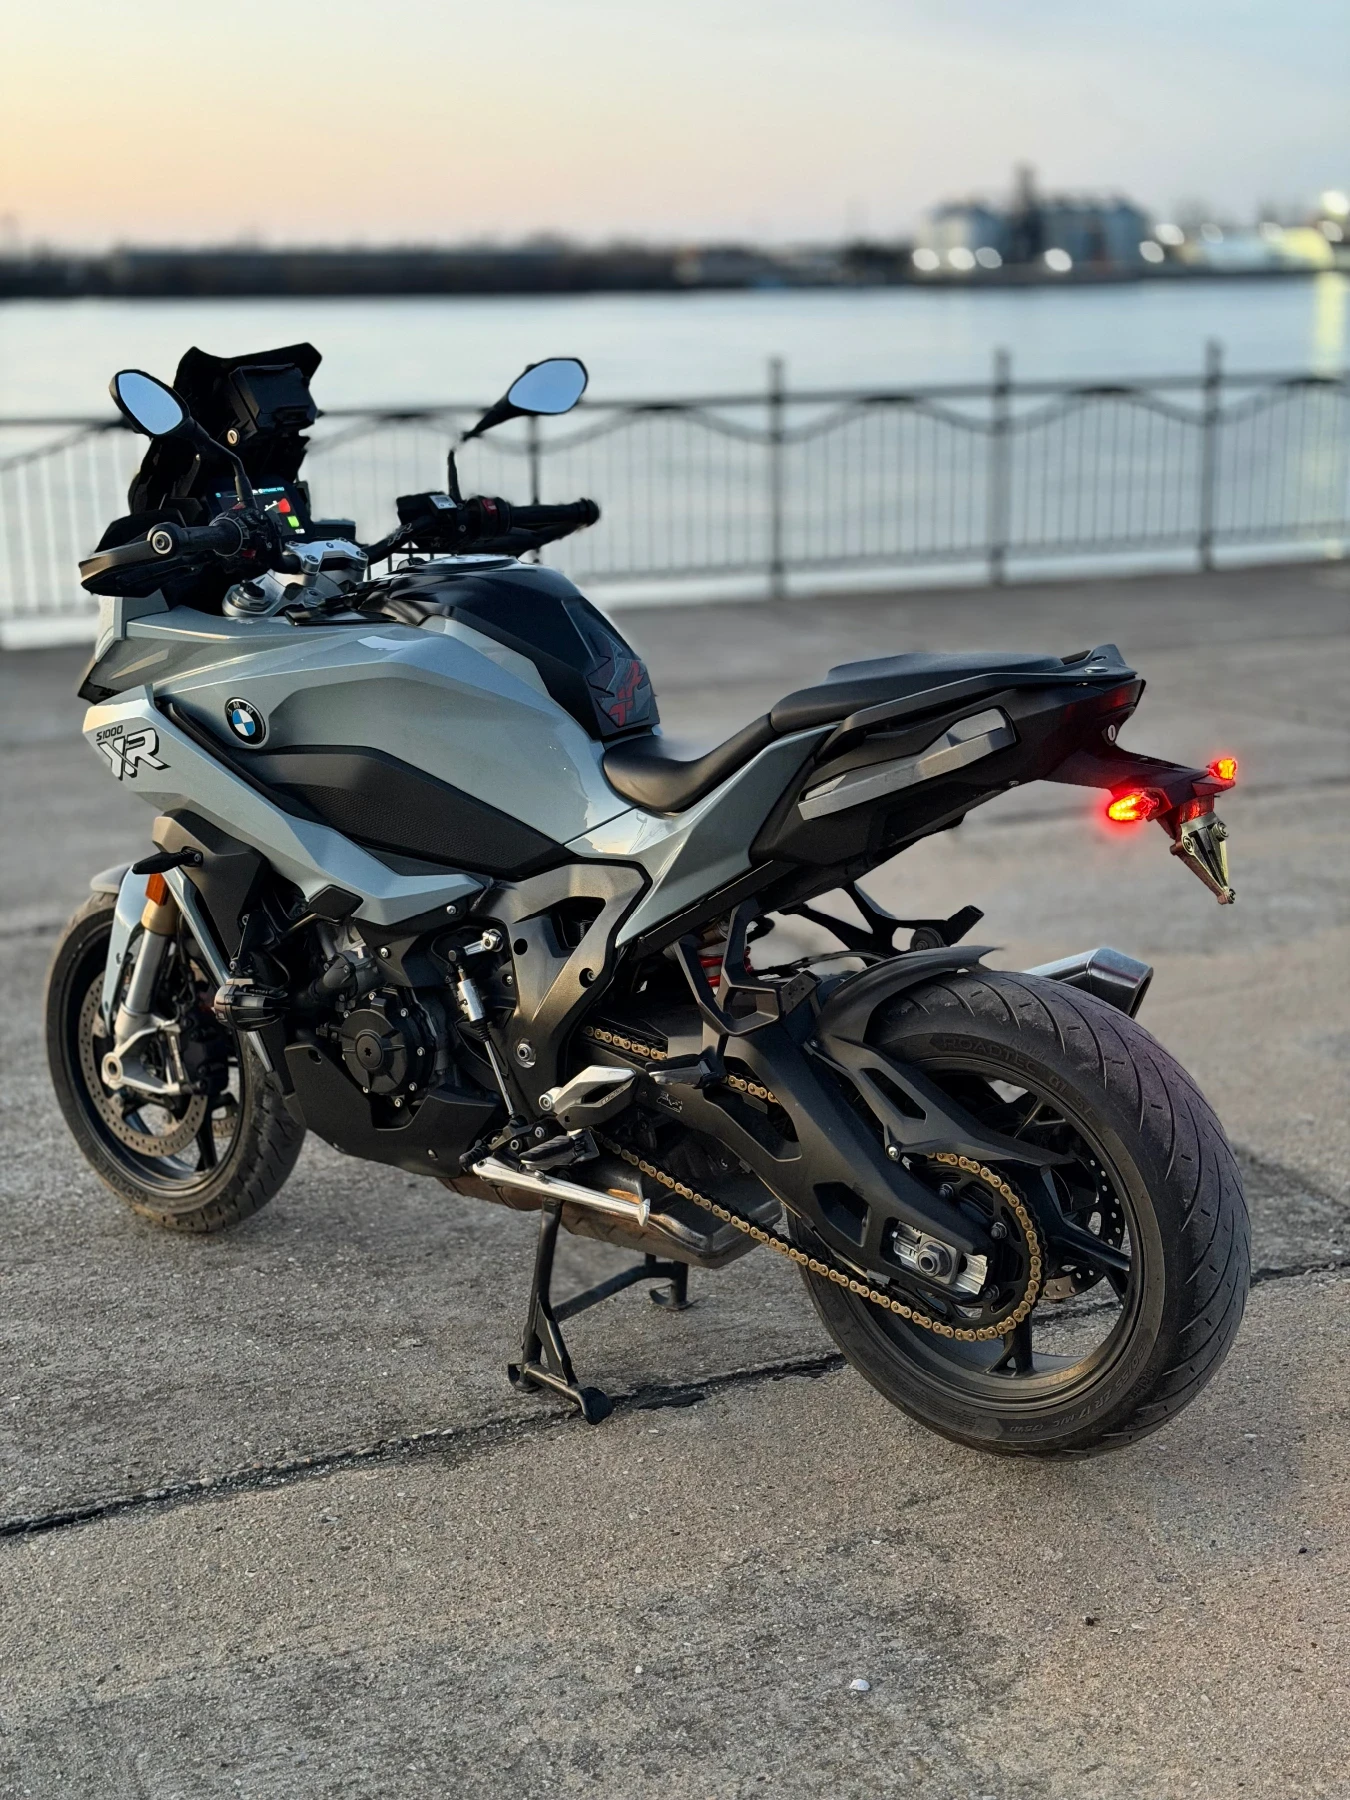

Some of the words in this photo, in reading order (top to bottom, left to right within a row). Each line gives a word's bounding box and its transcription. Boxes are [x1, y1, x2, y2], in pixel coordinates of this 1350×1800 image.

[227, 701, 254, 717] BMW
[96, 725, 123, 741] S1000
[97, 727, 171, 781] XR
[943, 1037, 1038, 1073] ROADTEC
